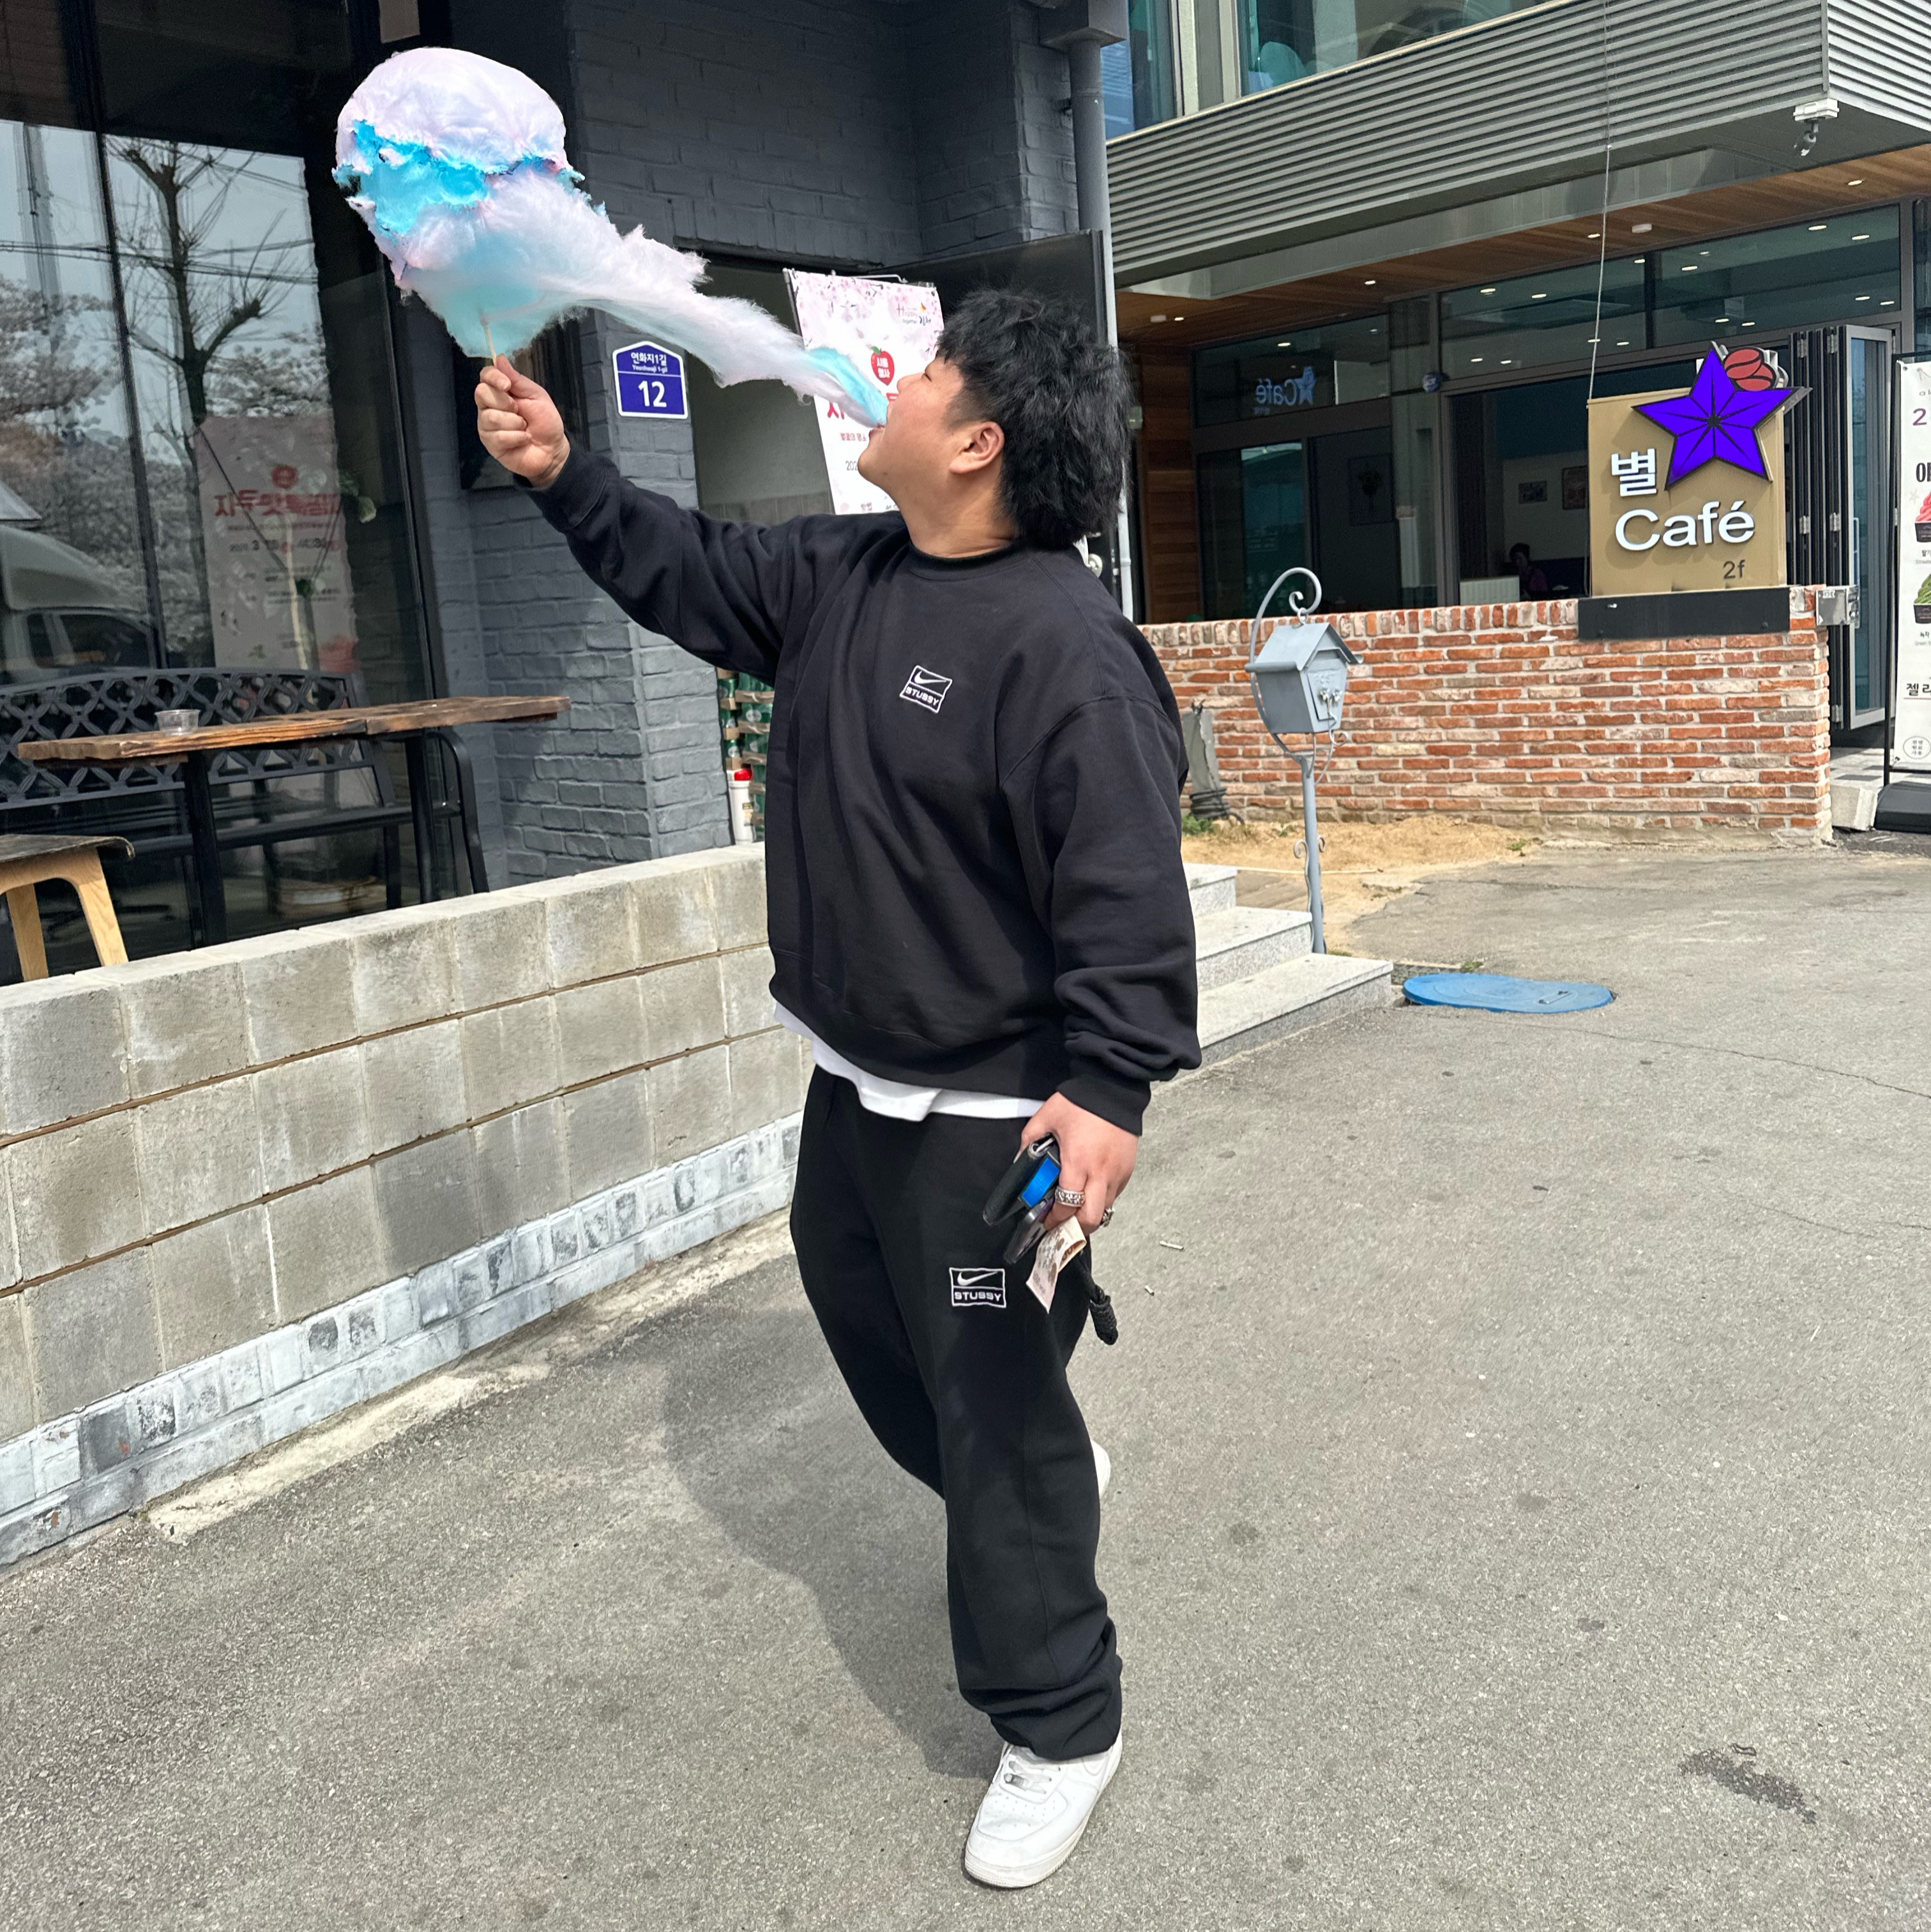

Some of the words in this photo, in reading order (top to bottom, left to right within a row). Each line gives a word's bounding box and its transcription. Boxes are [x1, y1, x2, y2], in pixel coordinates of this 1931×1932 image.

[631, 353, 667, 366] 연화지1길
[638, 380, 667, 407] 12
[1611, 448, 1657, 497] 별
[1616, 500, 1754, 551] Café
[1723, 559, 1745, 579] 2f
[905, 686, 939, 706] STUSSY
[954, 1291, 1001, 1302] STUSSY
